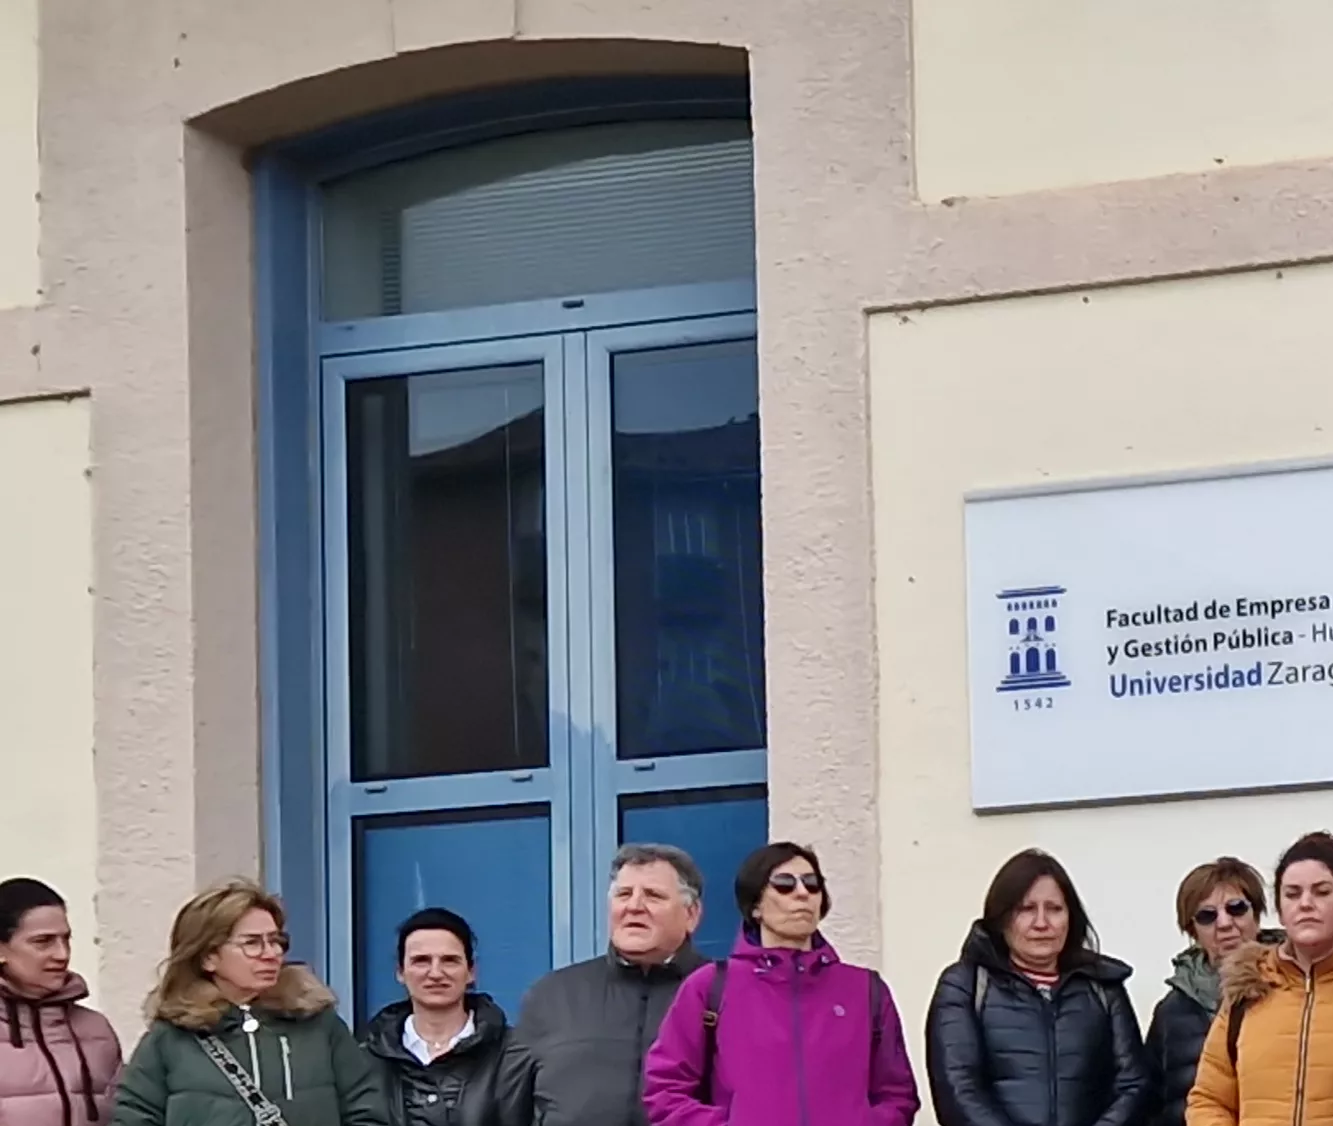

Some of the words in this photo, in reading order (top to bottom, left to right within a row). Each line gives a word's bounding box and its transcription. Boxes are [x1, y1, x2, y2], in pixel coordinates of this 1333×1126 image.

[1106, 603, 1198, 628] Facultad
[1204, 600, 1231, 619] de
[1236, 593, 1331, 618] Empresa
[1106, 644, 1119, 665] y
[1124, 632, 1208, 660] Gestión
[1213, 625, 1293, 651] Pública
[1110, 662, 1263, 698] Universidad
[1013, 697, 1054, 711] 1542
